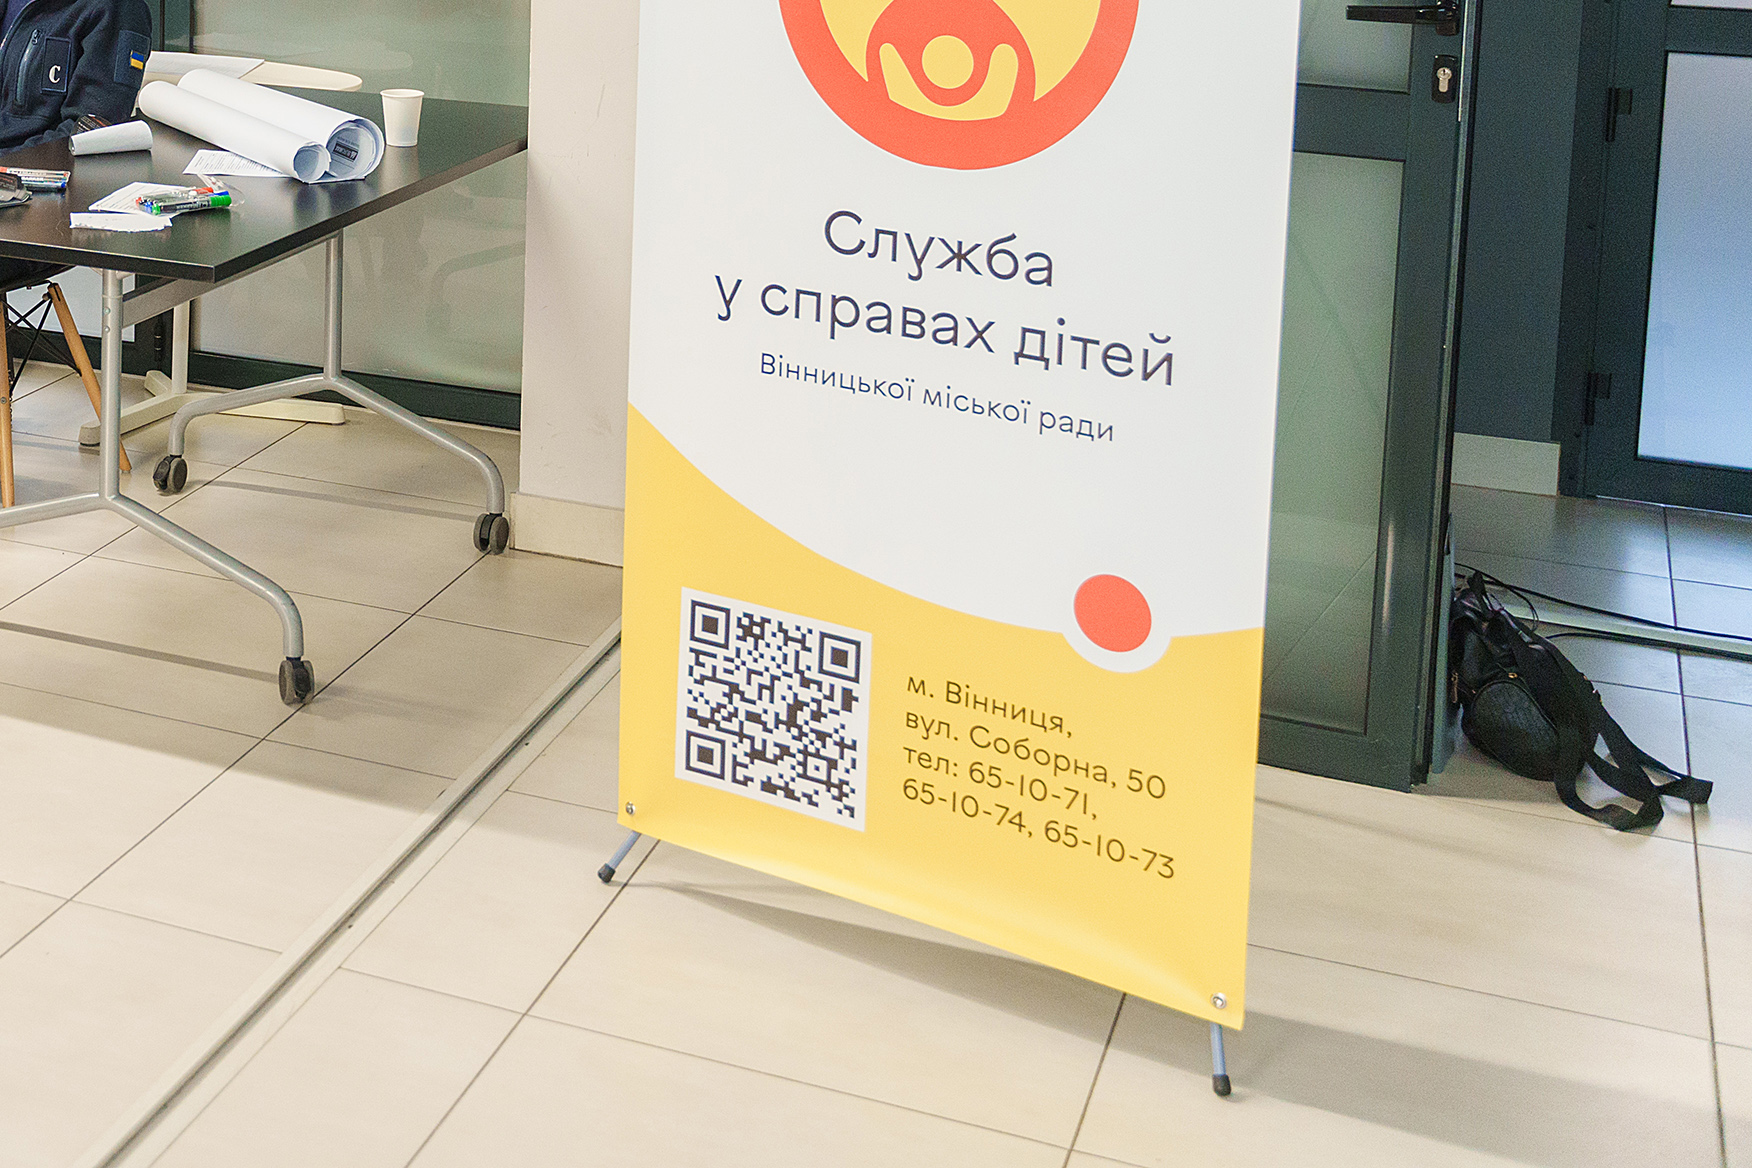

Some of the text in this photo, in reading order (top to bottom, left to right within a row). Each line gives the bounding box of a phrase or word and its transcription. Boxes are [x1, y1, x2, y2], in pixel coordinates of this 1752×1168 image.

[824, 210, 1053, 288] Служба
[714, 274, 1174, 387] у справах дітей
[760, 352, 1114, 442] Вінницької міської ради
[906, 676, 1072, 739] м. Вінниця,
[902, 746, 1097, 821] тел: 65-10-71,
[905, 711, 1166, 800] вул. Соборна, 50
[902, 777, 1175, 879] 65-10-74, 65-10-73
